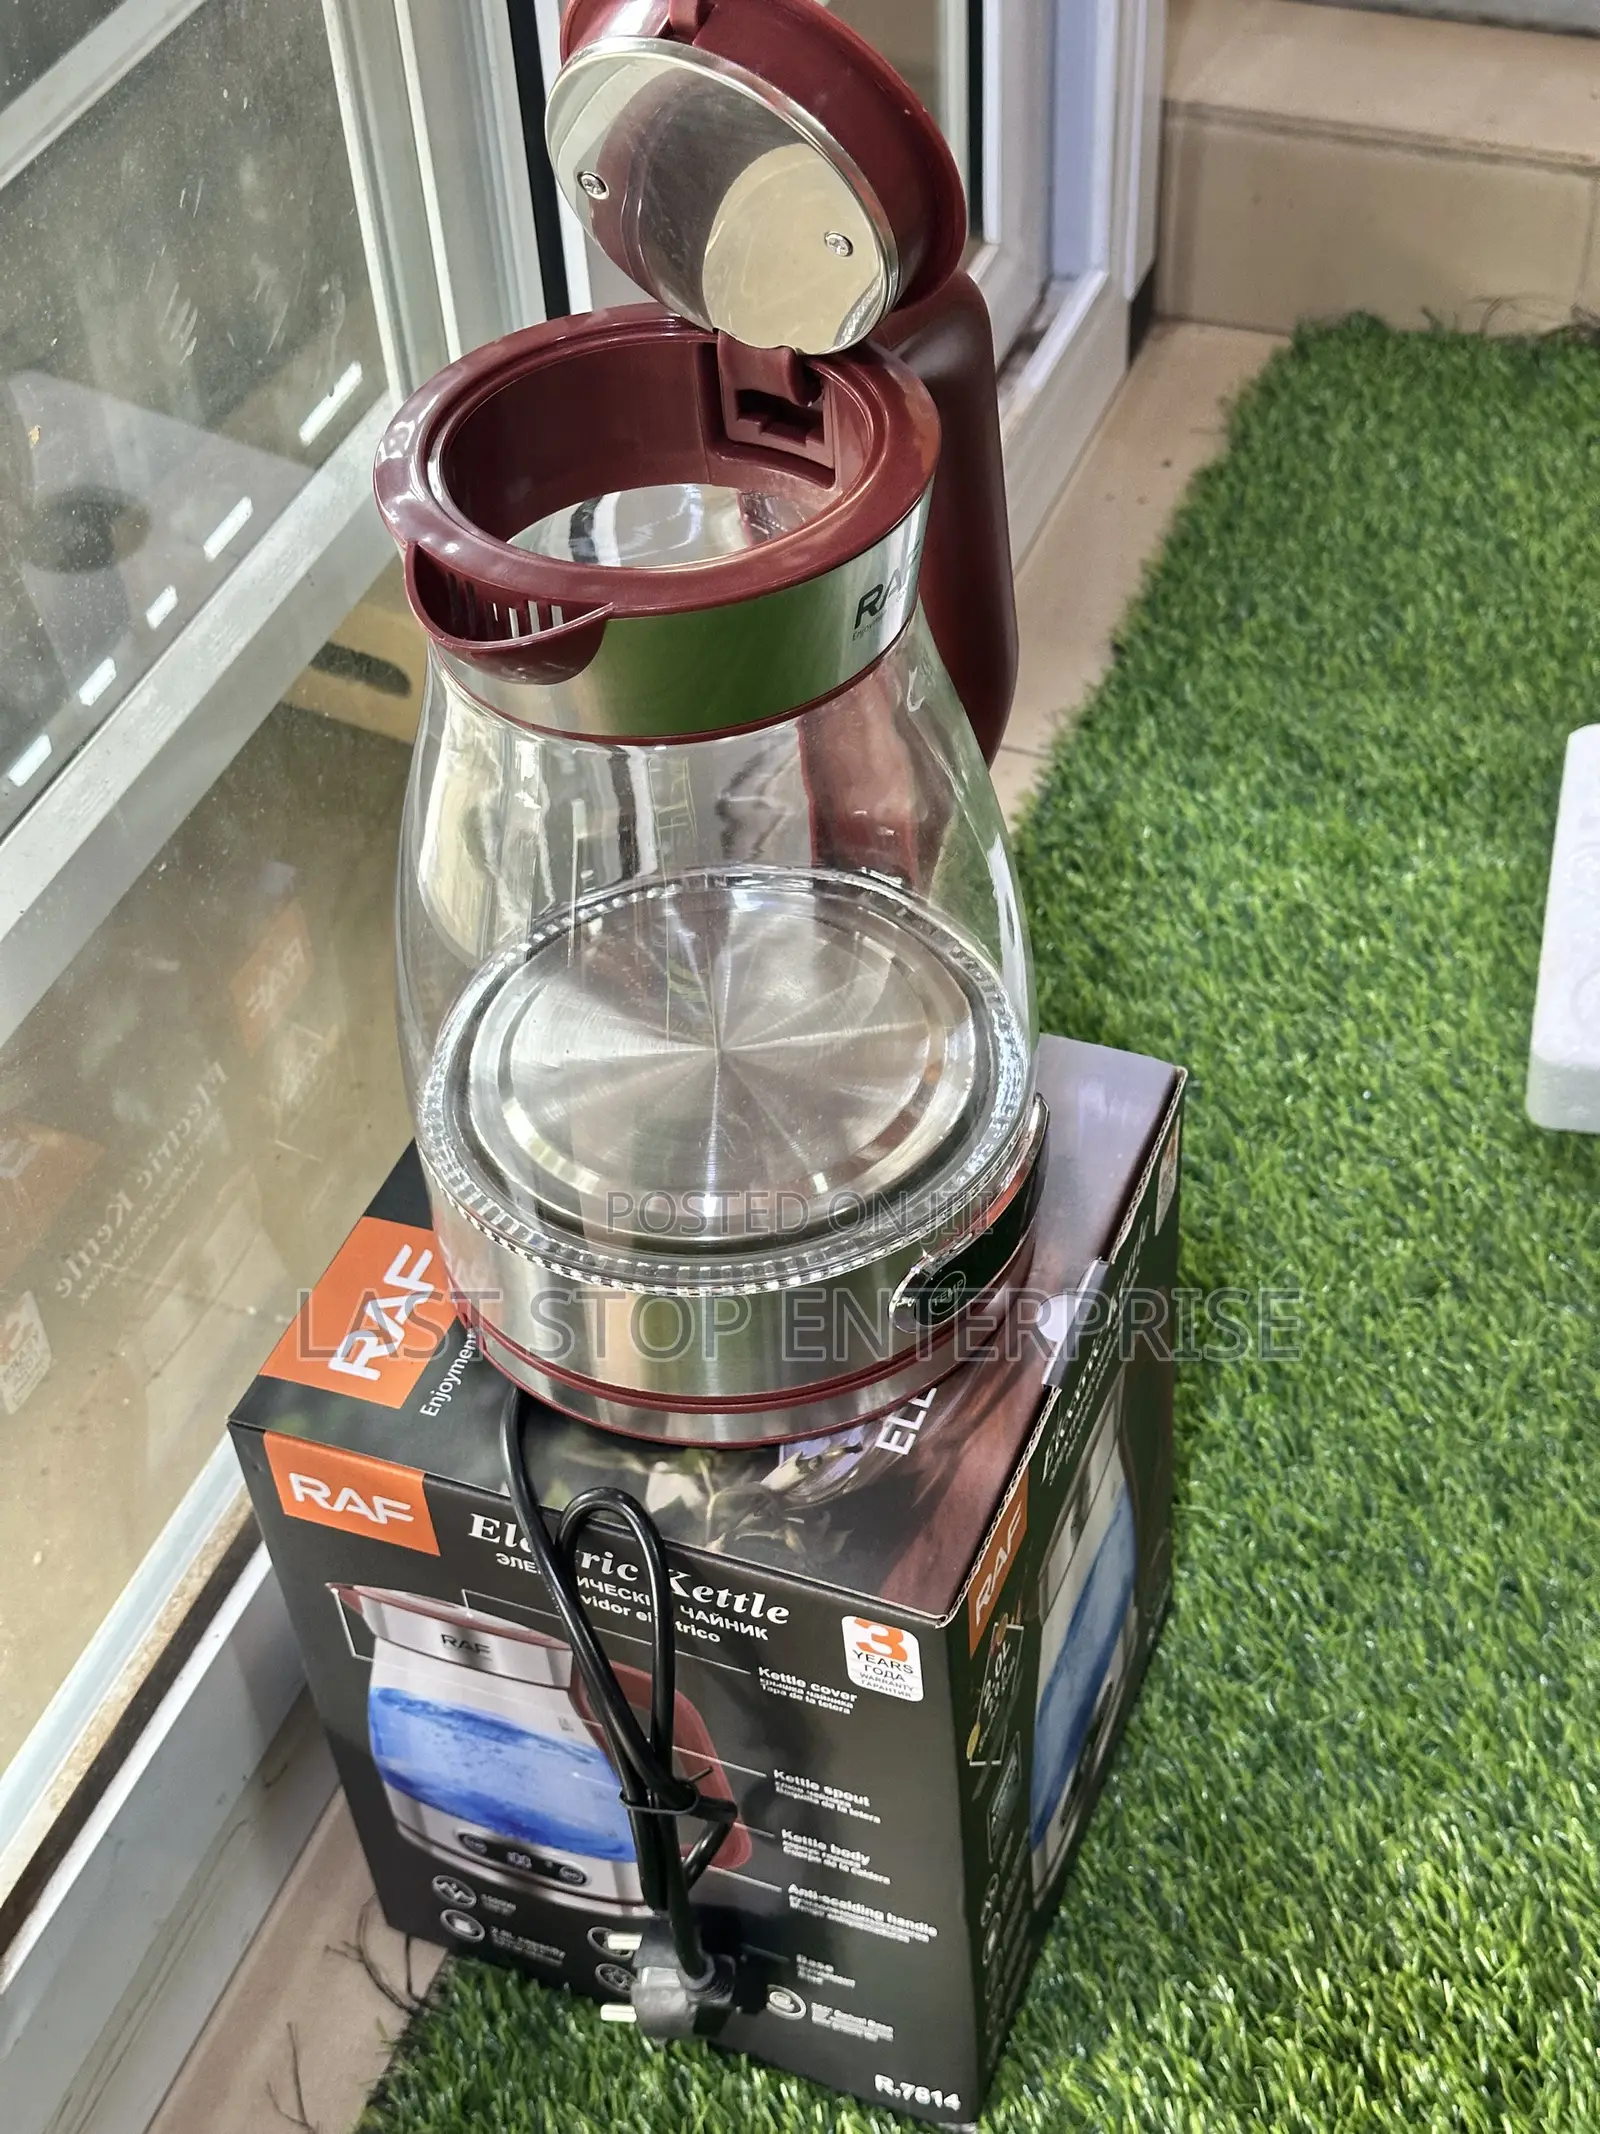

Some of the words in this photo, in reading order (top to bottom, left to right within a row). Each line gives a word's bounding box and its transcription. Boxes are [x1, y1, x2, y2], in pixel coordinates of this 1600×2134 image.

[932, 1279, 964, 1307] TEMP
[327, 1243, 435, 1381] RAF
[288, 1472, 415, 1525] RAF
[976, 1500, 1022, 1628] RAF
[668, 1568, 790, 1625] Kettle
[680, 1604, 769, 1641] ЧАЙНИК
[854, 1616, 909, 1663] 3
[440, 1633, 491, 1654] RAF
[852, 1649, 914, 1675] YEARS
[758, 1666, 807, 1689] Kettle
[810, 1683, 858, 1703] cover
[860, 1672, 914, 1693] WARRANTY
[864, 1665, 906, 1683] ГОДА
[773, 1769, 820, 1791] Kettle
[823, 1786, 871, 1807] spout
[781, 1828, 828, 1851] Kettle
[830, 1843, 871, 1867] body
[886, 1911, 939, 1938] handle
